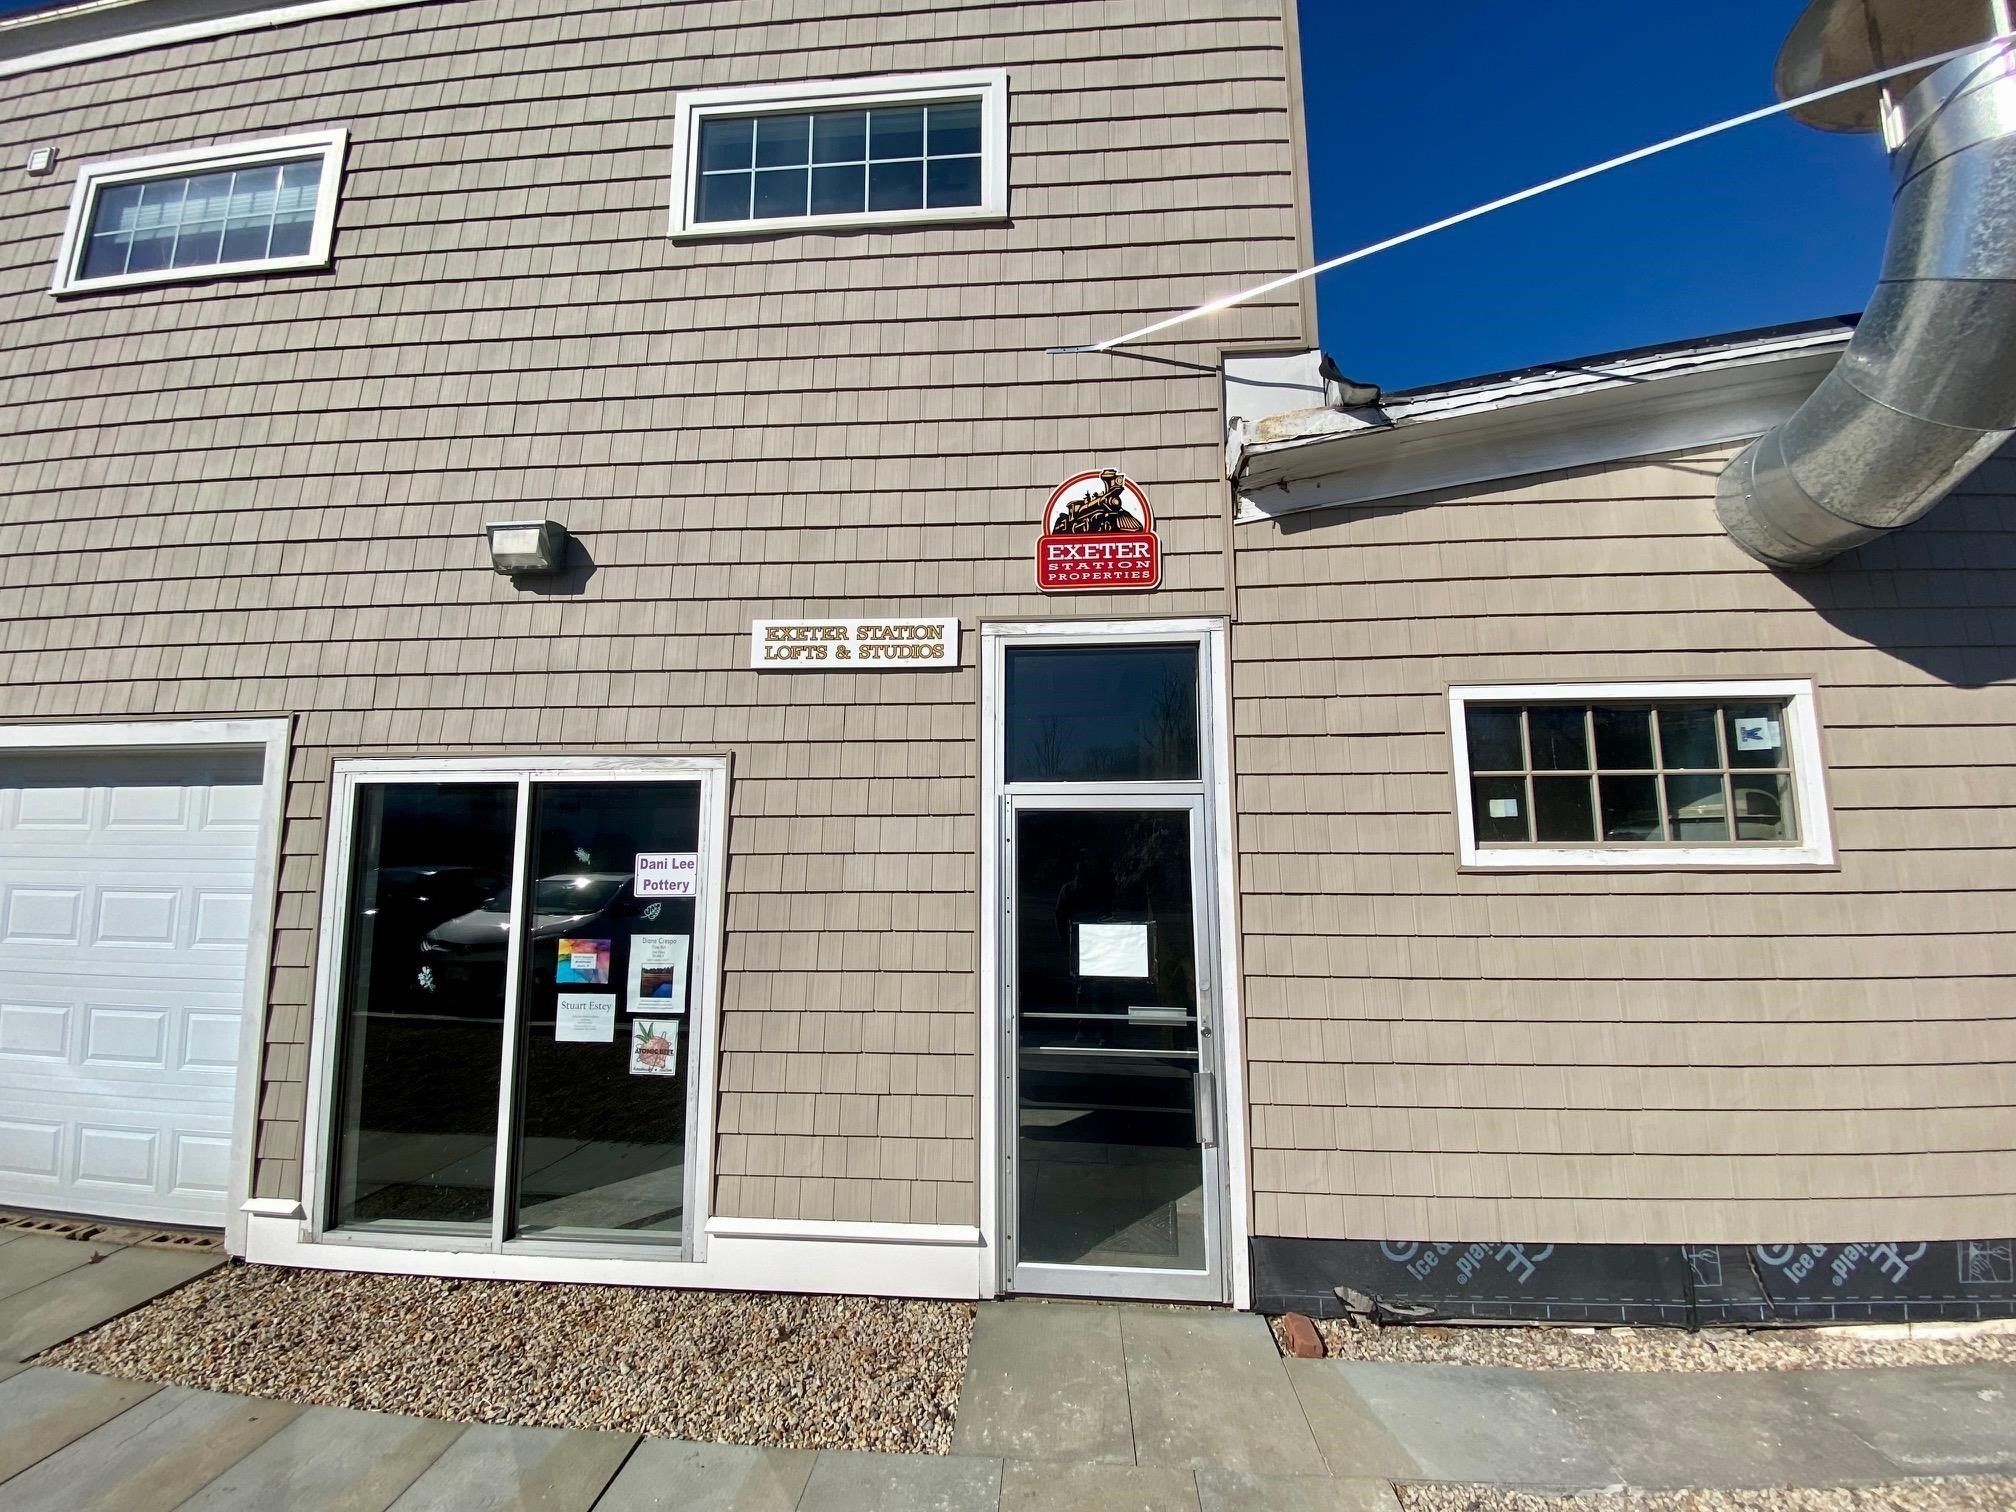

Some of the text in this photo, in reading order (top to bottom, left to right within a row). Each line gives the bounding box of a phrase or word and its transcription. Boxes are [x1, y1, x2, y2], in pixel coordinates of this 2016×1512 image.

[1047, 542, 1151, 561] EXETER
[1048, 560, 1151, 571] STATION
[1048, 570, 1151, 581] PROPERTIES
[764, 624, 945, 642] EXETER STATION
[764, 643, 945, 661] LOFTS & STUDIOS
[640, 858, 695, 870] Dani Lee
[643, 879, 690, 893] Pottery
[561, 1000, 611, 1014] Stuart Estey
[1406, 1250, 1439, 1281] Ice
[1782, 1252, 1815, 1284] Ice
